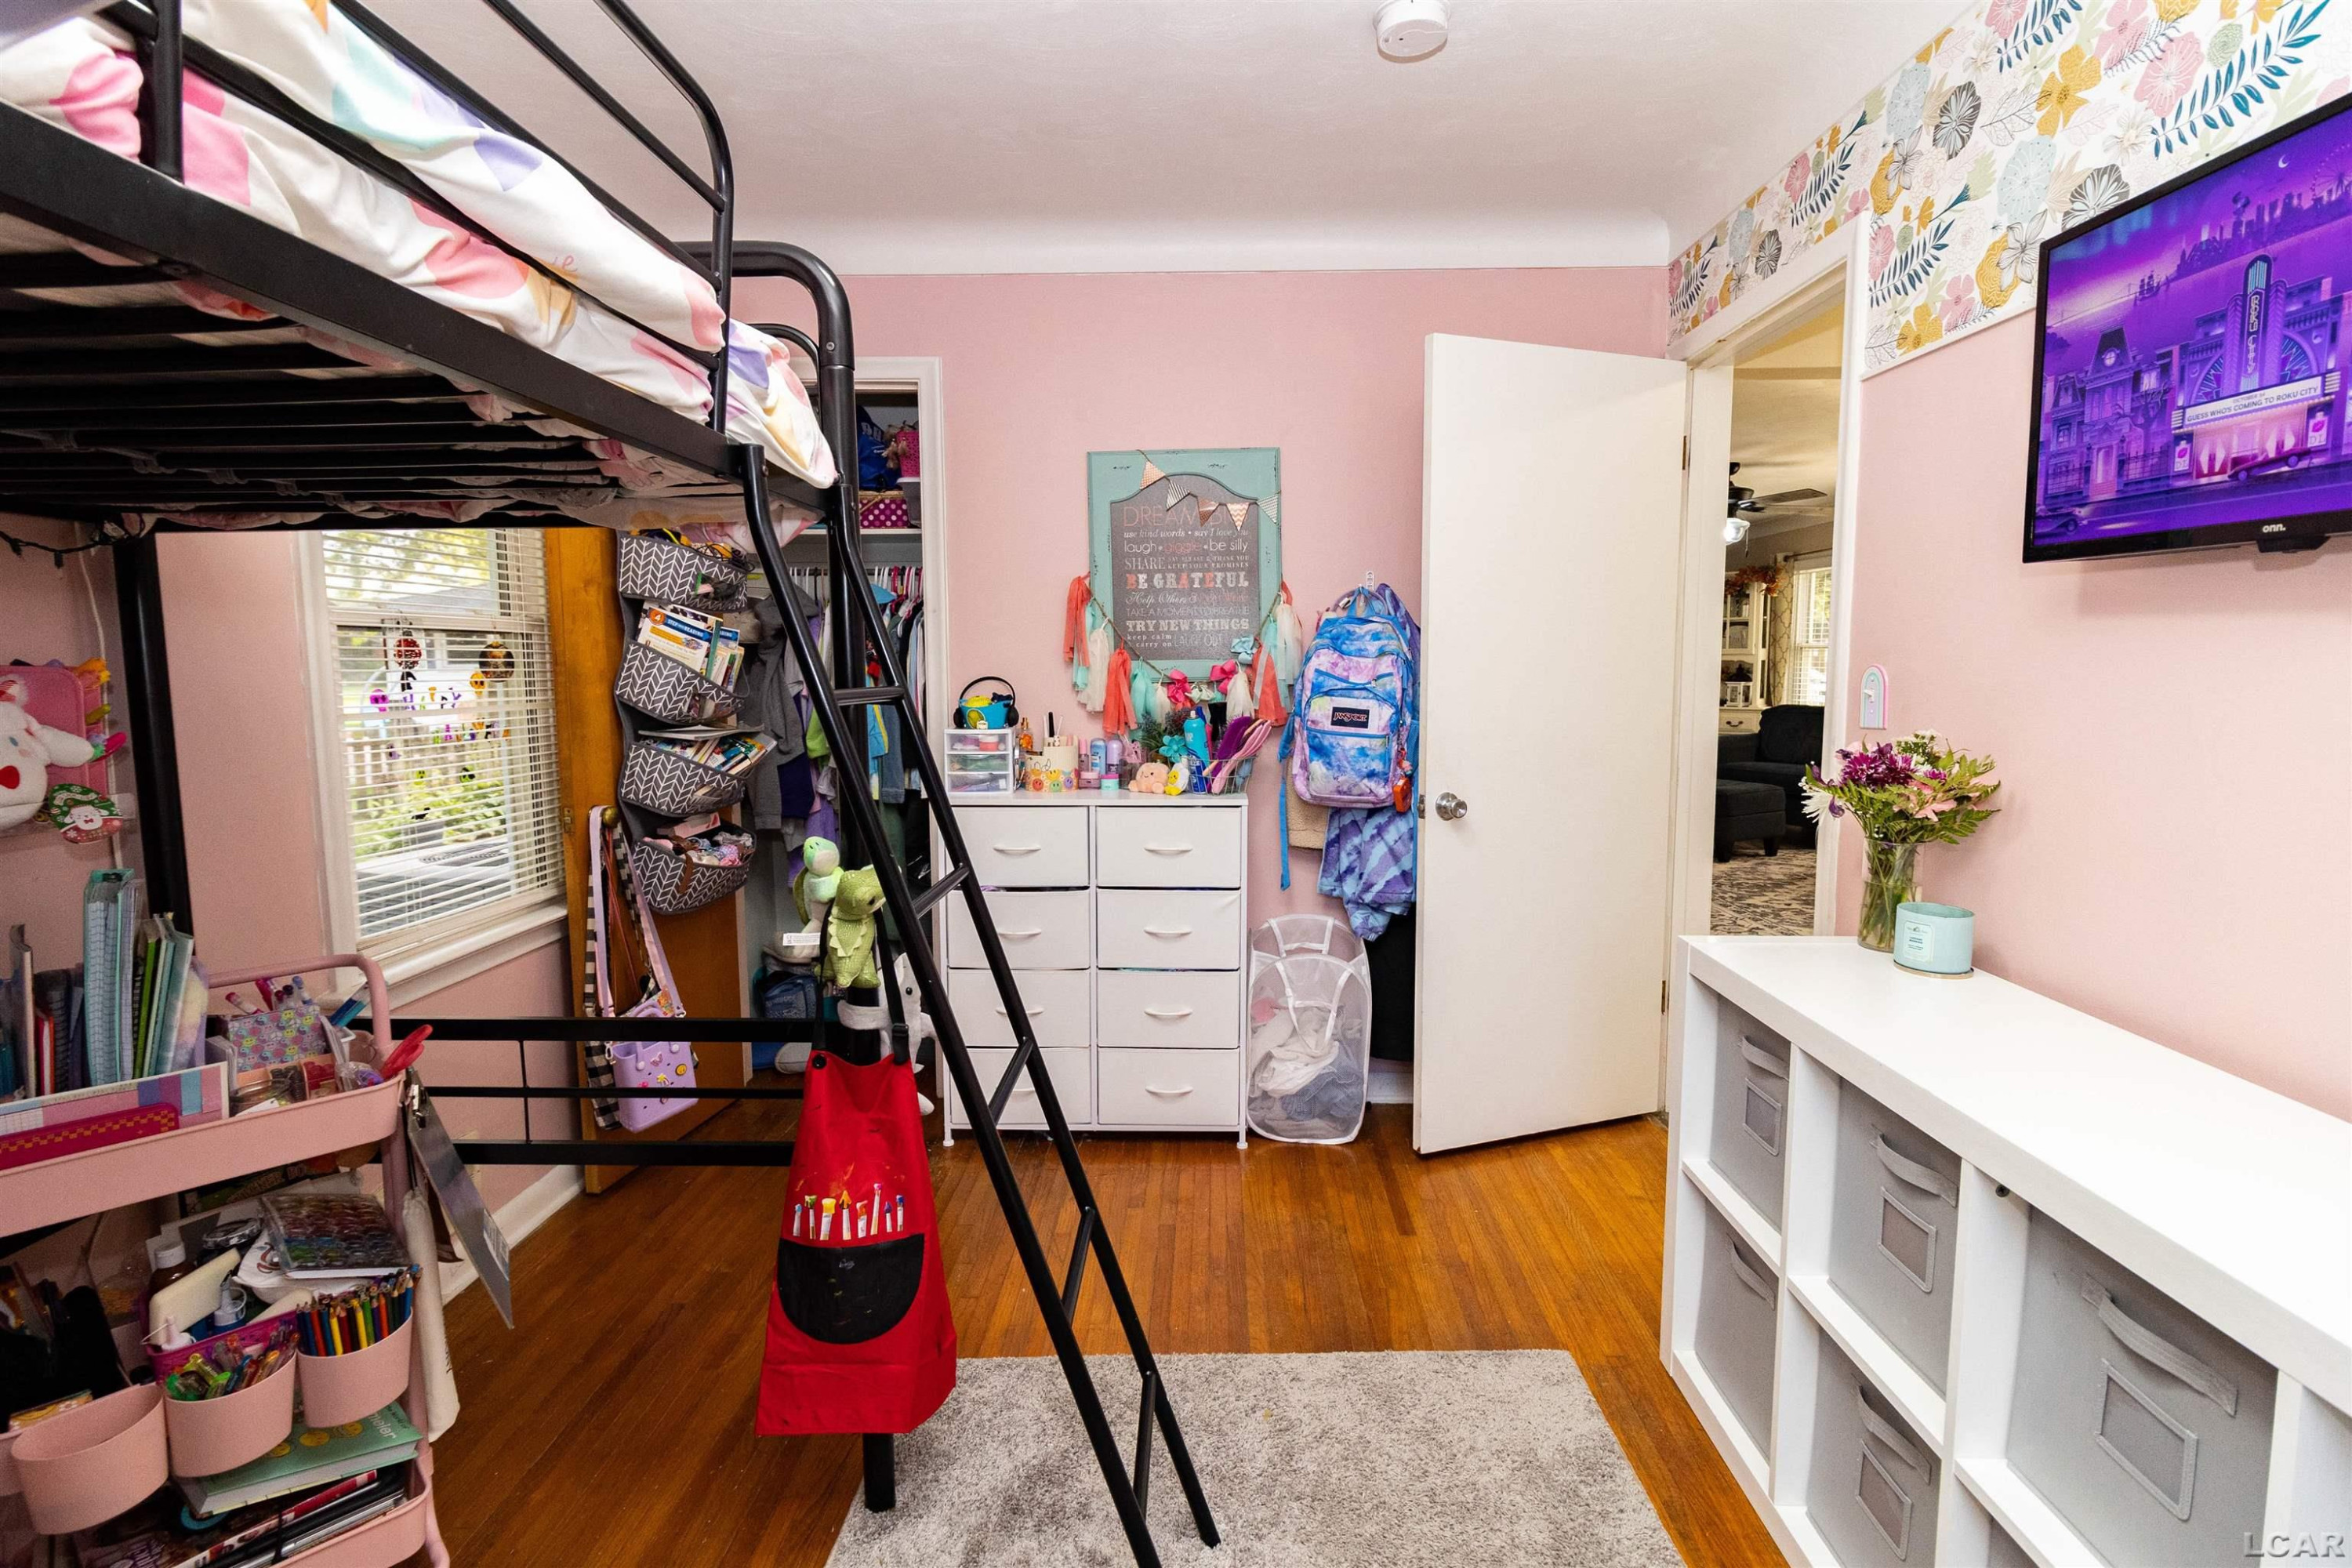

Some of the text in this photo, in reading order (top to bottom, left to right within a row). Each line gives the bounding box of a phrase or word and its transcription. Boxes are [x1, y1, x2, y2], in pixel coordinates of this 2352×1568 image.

[2187, 387, 2319, 422] GUESS WHO'S COMING TO ROKU CITY
[1123, 504, 1200, 526] DREAM
[1139, 528, 1158, 538] kind
[1160, 528, 1185, 537] words
[1123, 539, 1156, 554] laugh
[1210, 538, 1226, 550] be
[1230, 538, 1249, 553] silly
[1124, 557, 1166, 570] SHARE
[1126, 572, 1249, 590] BE GRATEFUL
[1125, 592, 1155, 608] Help
[1159, 590, 1187, 604] Others
[1126, 608, 1145, 617] TAKE
[667, 619, 678, 628] STEP
[684, 626, 704, 638] READING
[1126, 619, 1250, 632] TRY NEW THINGS
